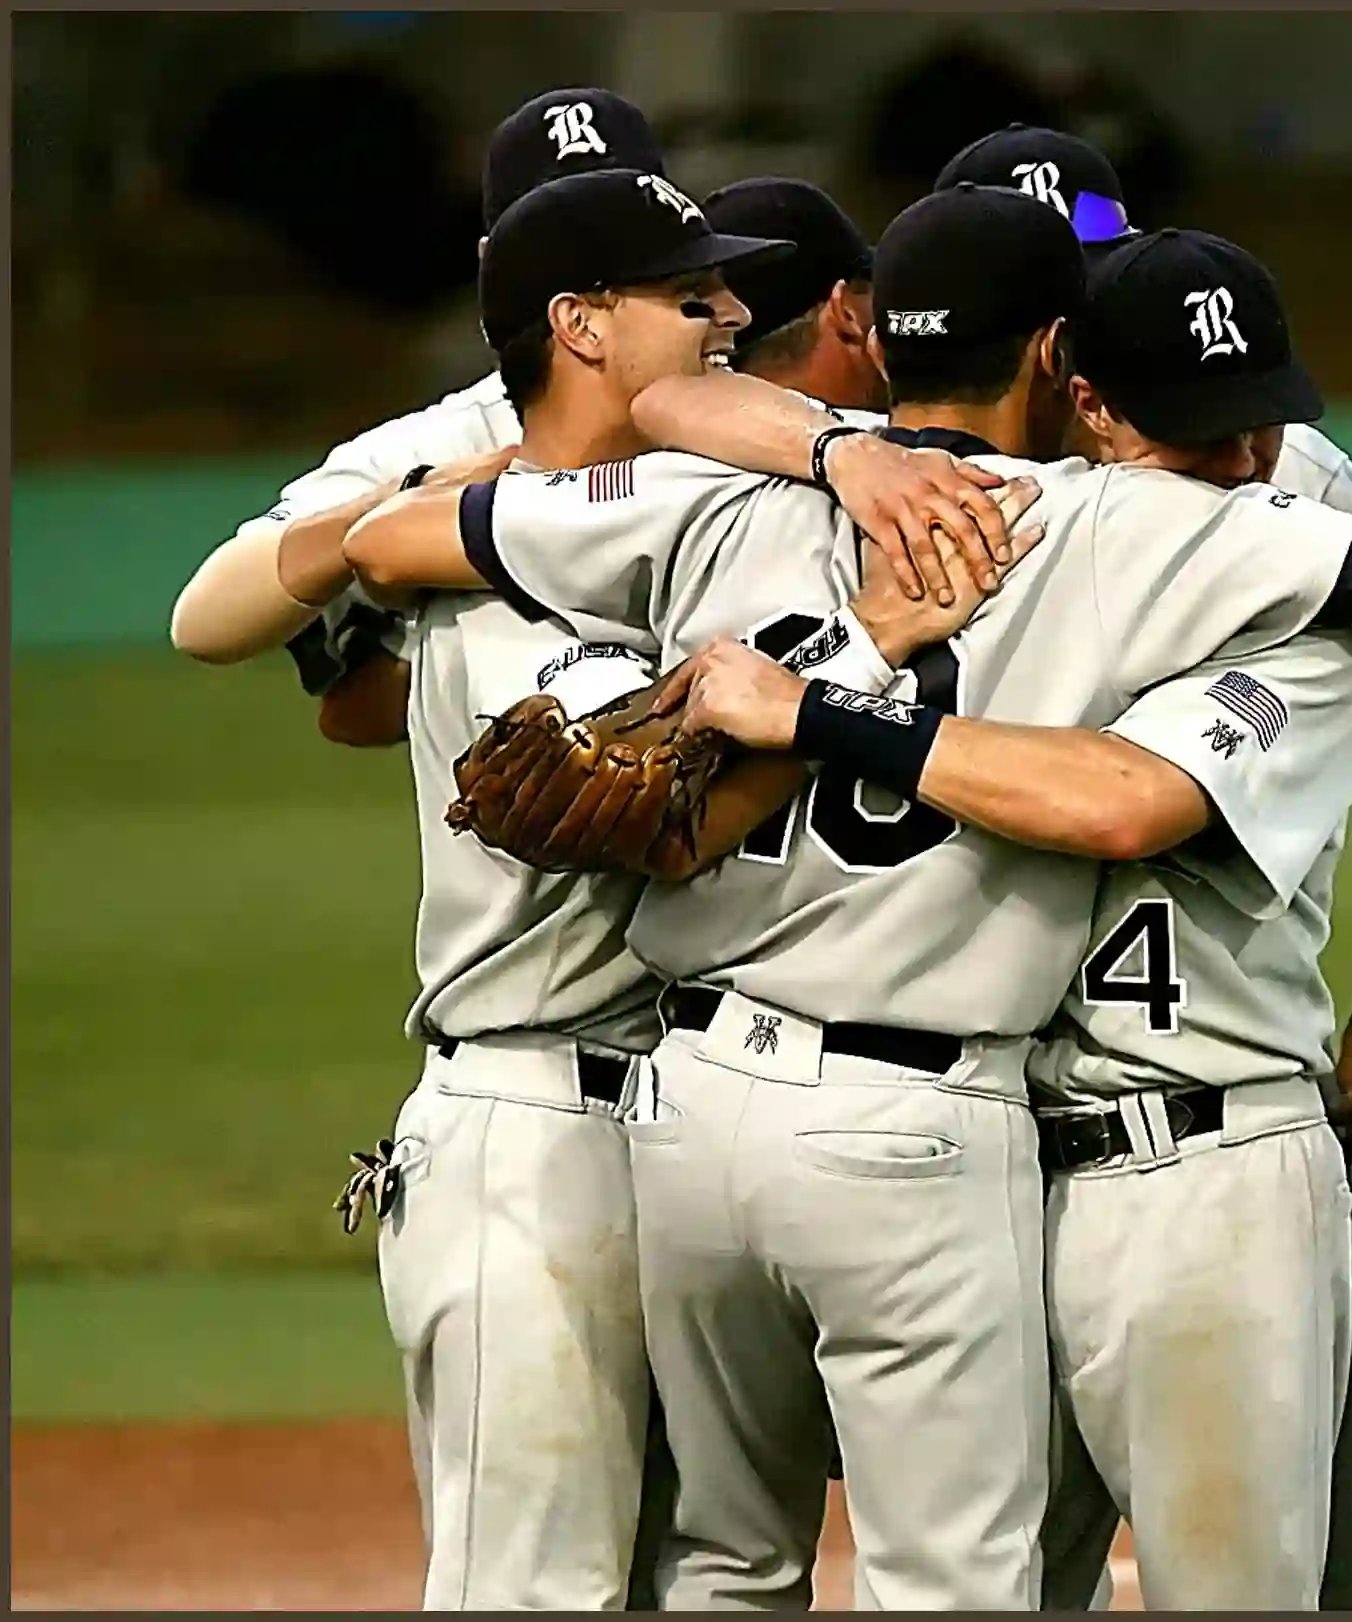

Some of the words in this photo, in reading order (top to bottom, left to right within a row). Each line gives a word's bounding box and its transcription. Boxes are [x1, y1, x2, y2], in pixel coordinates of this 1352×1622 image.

[543, 101, 608, 161] R
[1010, 160, 1071, 219] R
[886, 309, 951, 336] TPX
[1183, 285, 1250, 362] R
[821, 681, 926, 727] TPX
[1080, 898, 1187, 1036] 4
